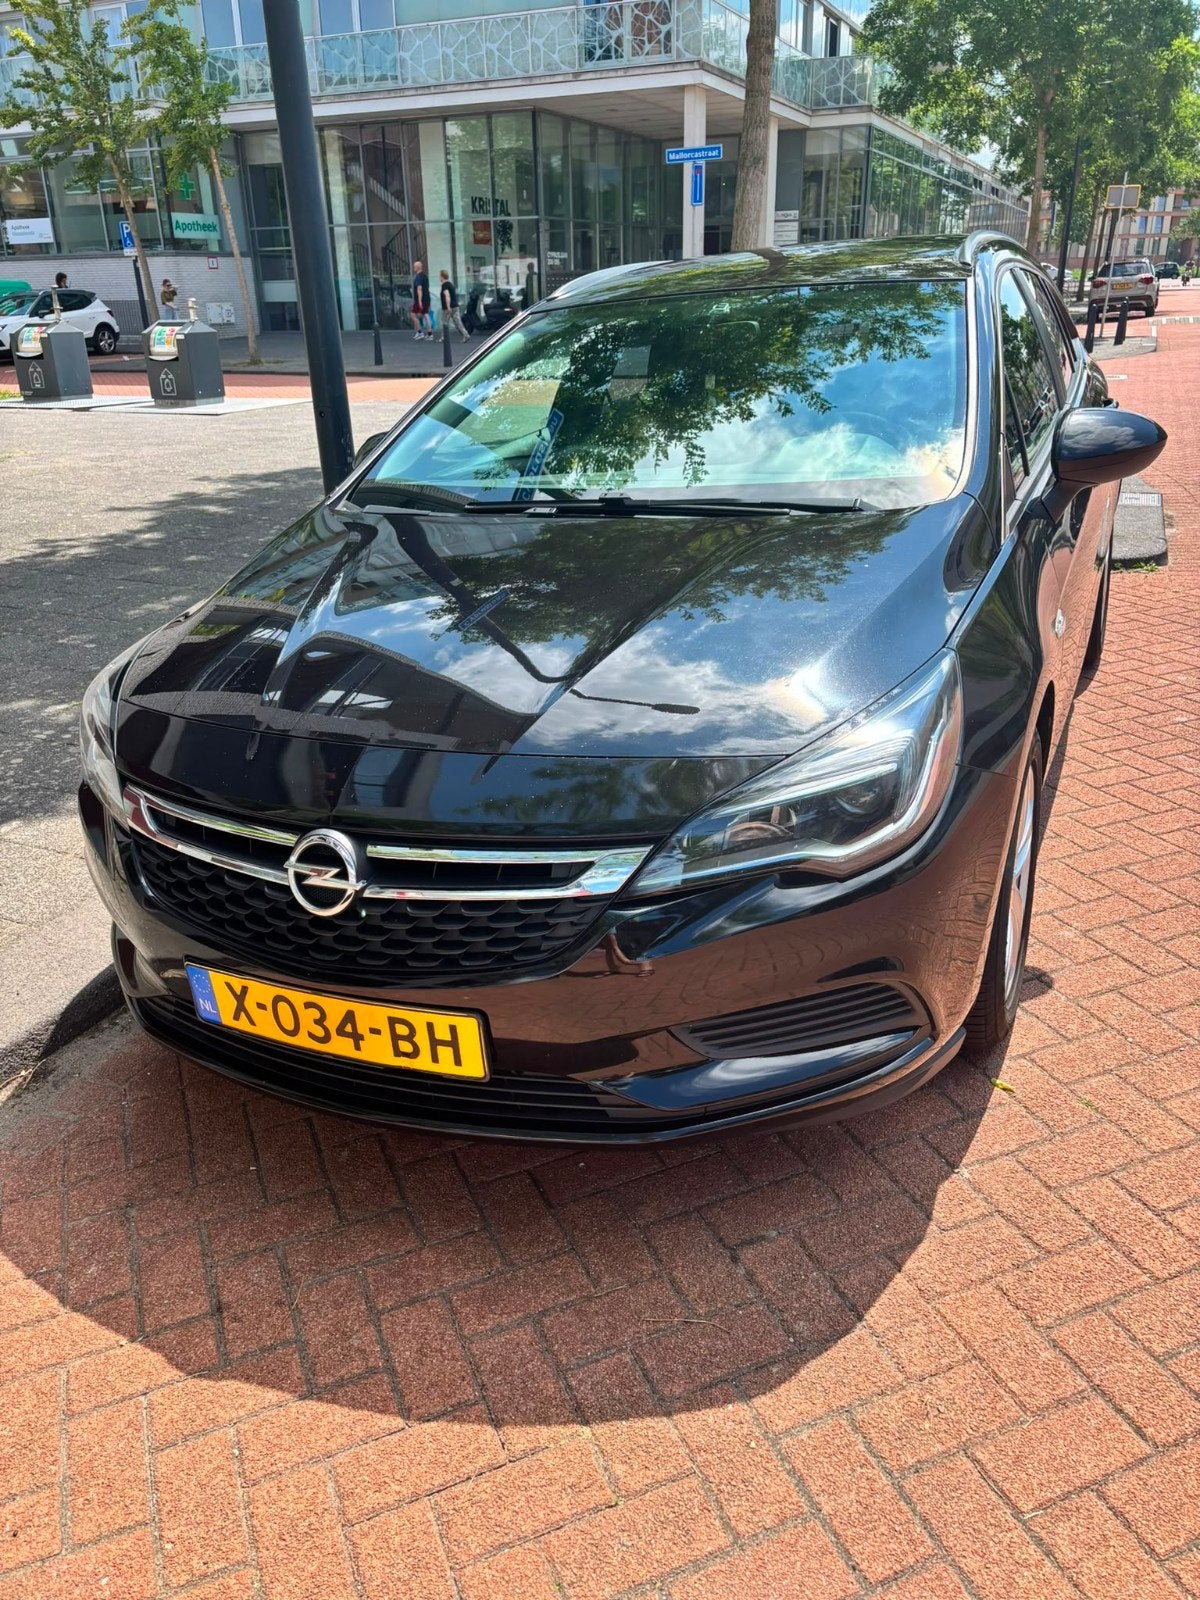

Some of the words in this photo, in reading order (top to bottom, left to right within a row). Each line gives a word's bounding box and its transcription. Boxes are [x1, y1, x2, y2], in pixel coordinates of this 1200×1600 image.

[668, 148, 719, 160] Mallorcastraat
[174, 219, 218, 234] Apotheek
[199, 998, 217, 1013] NL
[223, 980, 463, 1067] X-034-BH
